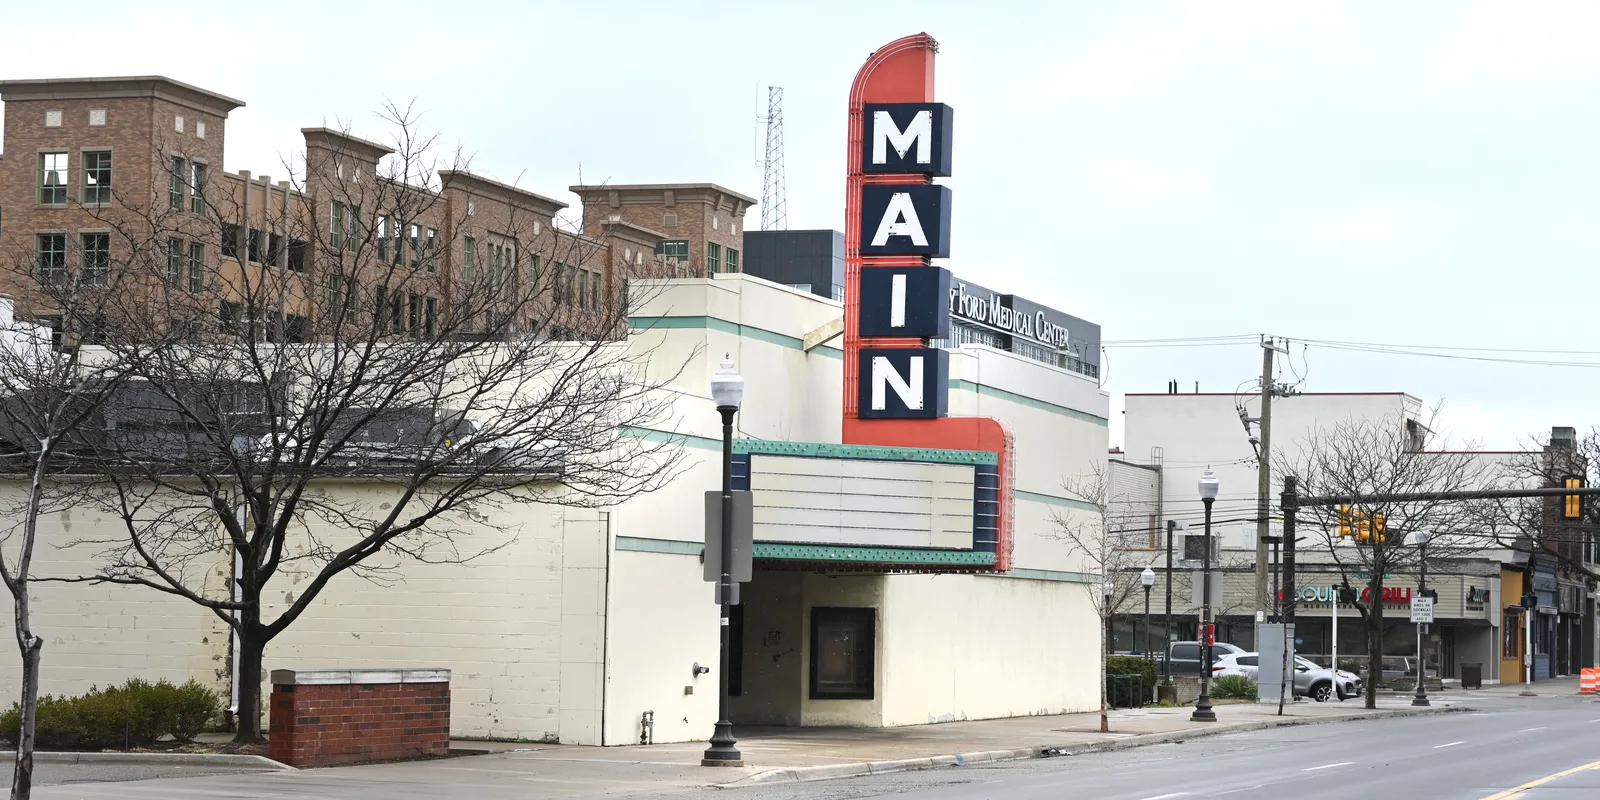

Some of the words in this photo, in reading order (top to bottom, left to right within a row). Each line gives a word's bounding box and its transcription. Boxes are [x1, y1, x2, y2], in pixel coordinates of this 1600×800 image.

[871, 110, 933, 411] MAIN
[958, 282, 986, 322] FORD
[989, 293, 1033, 336] MEDICAL
[1035, 310, 1070, 351] CENTER
